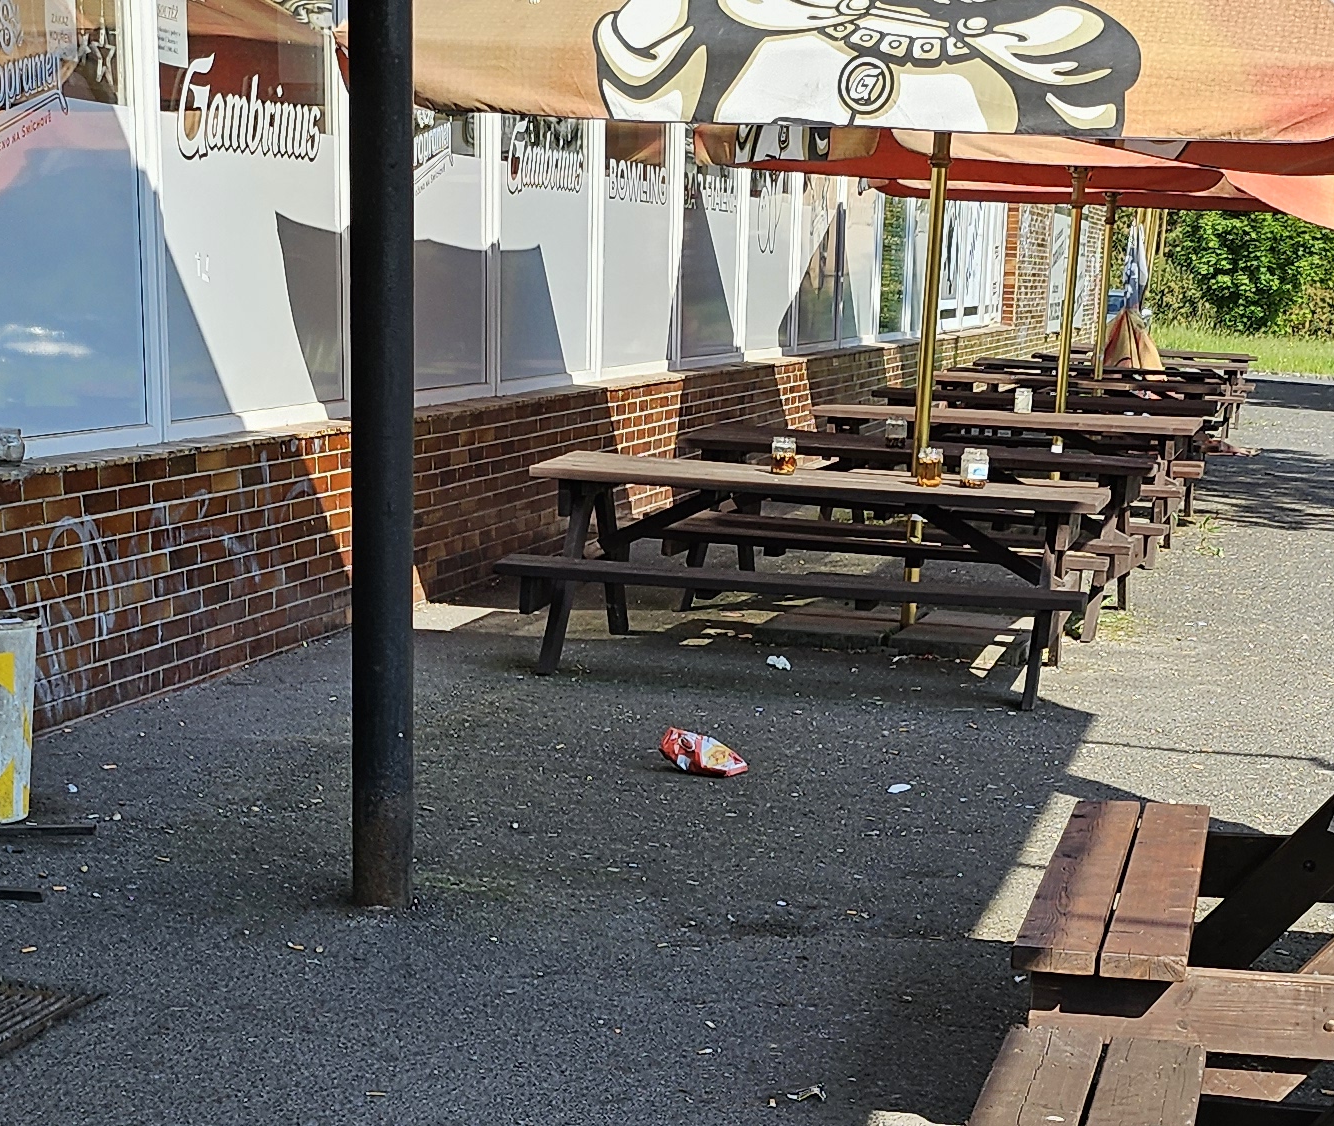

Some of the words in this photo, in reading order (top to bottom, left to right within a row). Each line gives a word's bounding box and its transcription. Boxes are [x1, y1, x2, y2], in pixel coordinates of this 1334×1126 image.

[177, 52, 322, 161] Gambrinus
[507, 117, 584, 195] Gambrinus
[609, 158, 667, 205] BOWLING
